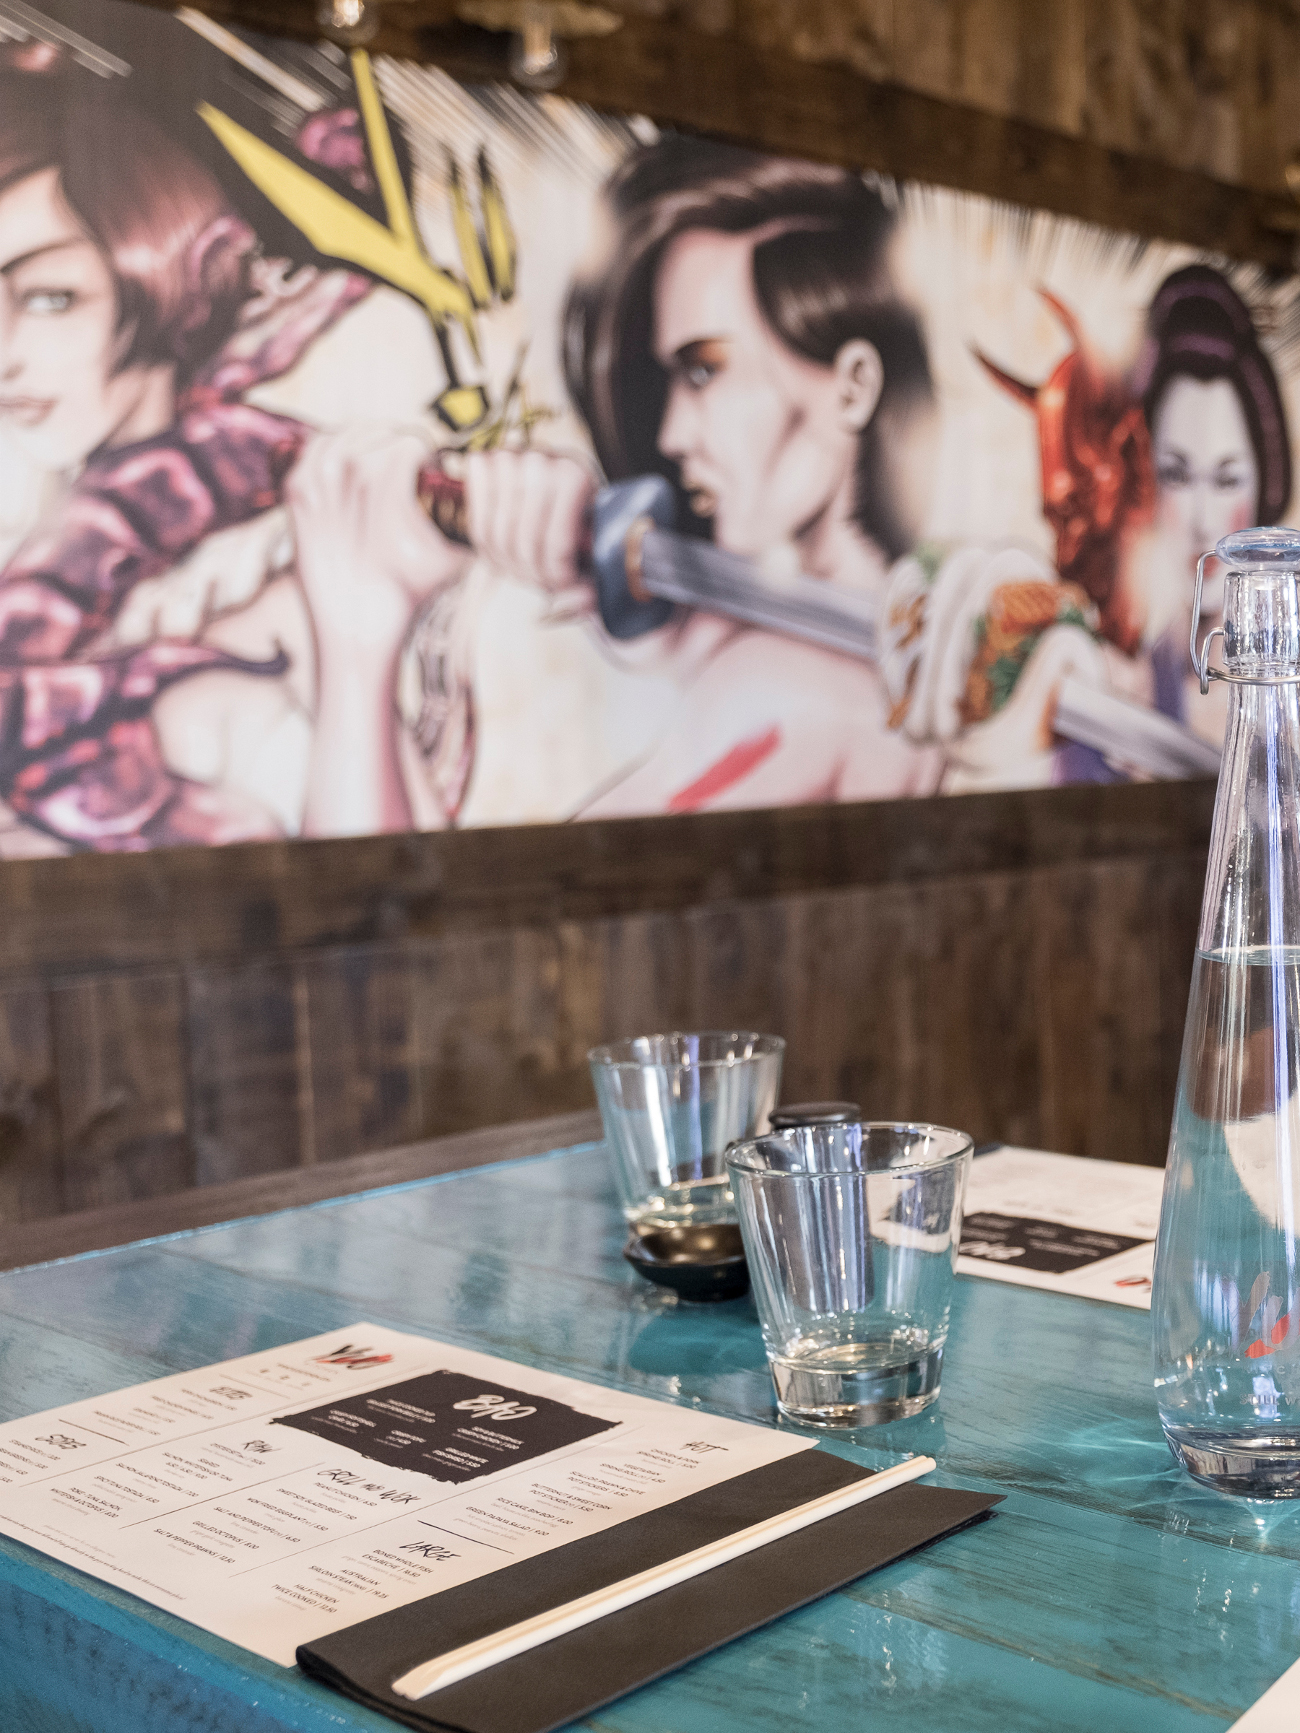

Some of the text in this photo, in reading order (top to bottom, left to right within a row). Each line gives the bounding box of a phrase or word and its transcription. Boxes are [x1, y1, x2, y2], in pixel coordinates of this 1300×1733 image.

[453, 1394, 537, 1421] BAO
[1239, 1393, 1279, 1406] STILL
[681, 1440, 730, 1454] HOT
[317, 1469, 366, 1486] GRILL
[579, 1481, 609, 1491] STICKERS
[276, 1488, 297, 1496] SWEET
[314, 1482, 338, 1491] PEANUT
[335, 1490, 360, 1501] CHICKEN
[379, 1490, 420, 1504] WOK
[531, 1483, 567, 1496] BUTTERNUT
[566, 1495, 594, 1504] SWEET
[260, 1502, 277, 1510] FRIED
[275, 1508, 307, 1521] EGGPLANT
[465, 1506, 487, 1516] GREEN
[484, 1513, 510, 1524] PAPAYA
[509, 1522, 531, 1530] SALAD
[192, 1521, 218, 1532] GRILLED
[214, 1530, 243, 1543] OCTOPUS
[239, 1516, 263, 1527] PEPPER
[261, 1525, 278, 1533] TOFU
[171, 1535, 195, 1546] PEPPER
[192, 1545, 217, 1556] PRAWNS
[399, 1541, 461, 1561] LARGE
[361, 1554, 400, 1569] ESCABECHE
[373, 1549, 433, 1574] BONED WHOLE FISH
[309, 1565, 333, 1577] SIRLOIN
[332, 1575, 353, 1584] STEAK
[341, 1569, 379, 1586] AUSTRALIAN
[272, 1584, 291, 1594] TWICE
[289, 1593, 317, 1604] COOKED
[294, 1584, 312, 1592] HALF
[310, 1591, 338, 1604] CHICKEN
